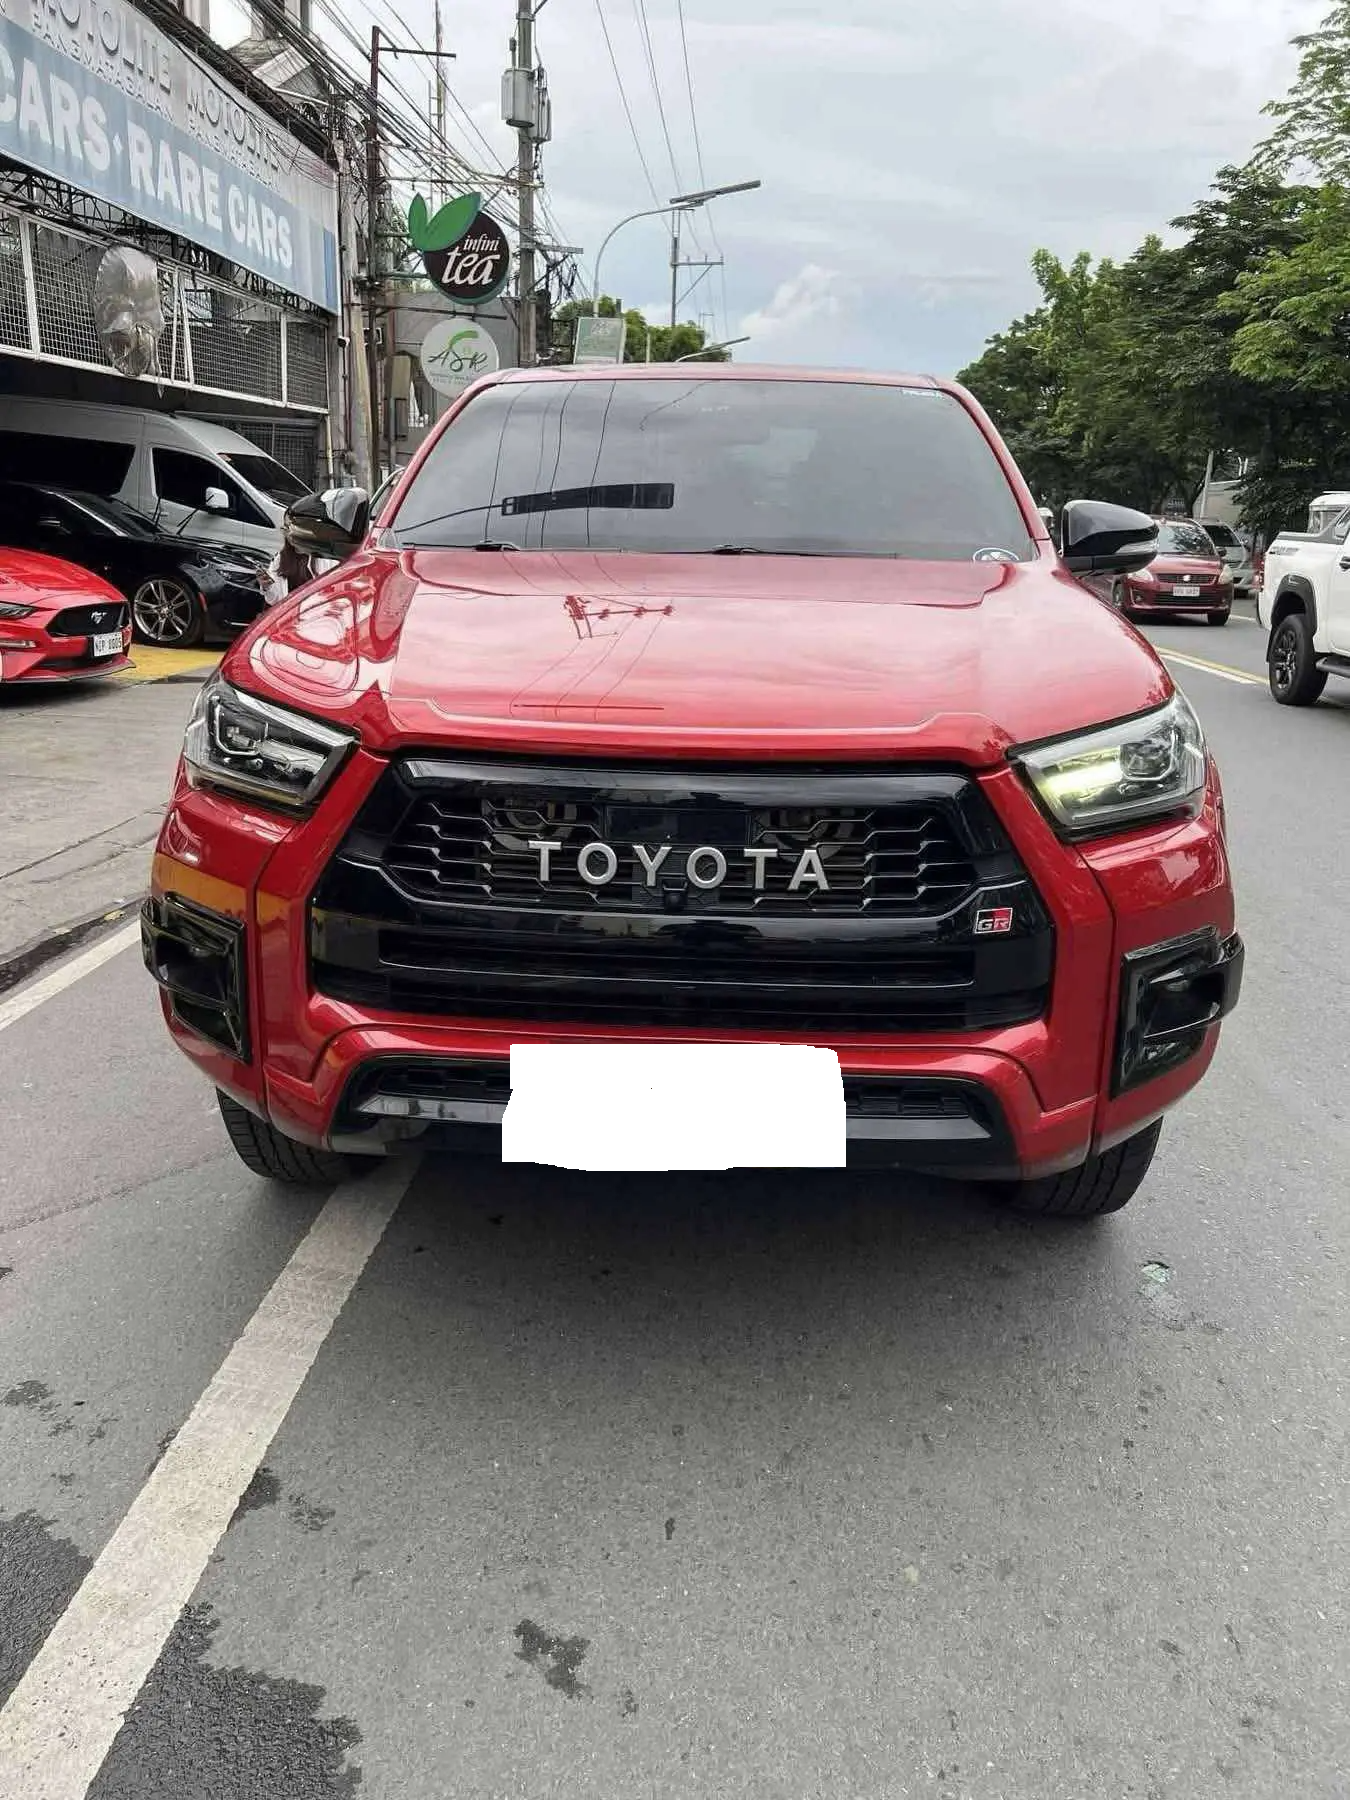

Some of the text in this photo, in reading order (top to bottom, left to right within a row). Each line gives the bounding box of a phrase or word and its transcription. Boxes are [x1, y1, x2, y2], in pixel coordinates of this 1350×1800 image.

[32, 0, 172, 95] TOLITE
[127, 120, 223, 232] RARE
[228, 184, 293, 269] CARS
[441, 245, 501, 285] tea
[463, 233, 501, 252] infini
[528, 841, 830, 891] TOYOTA
